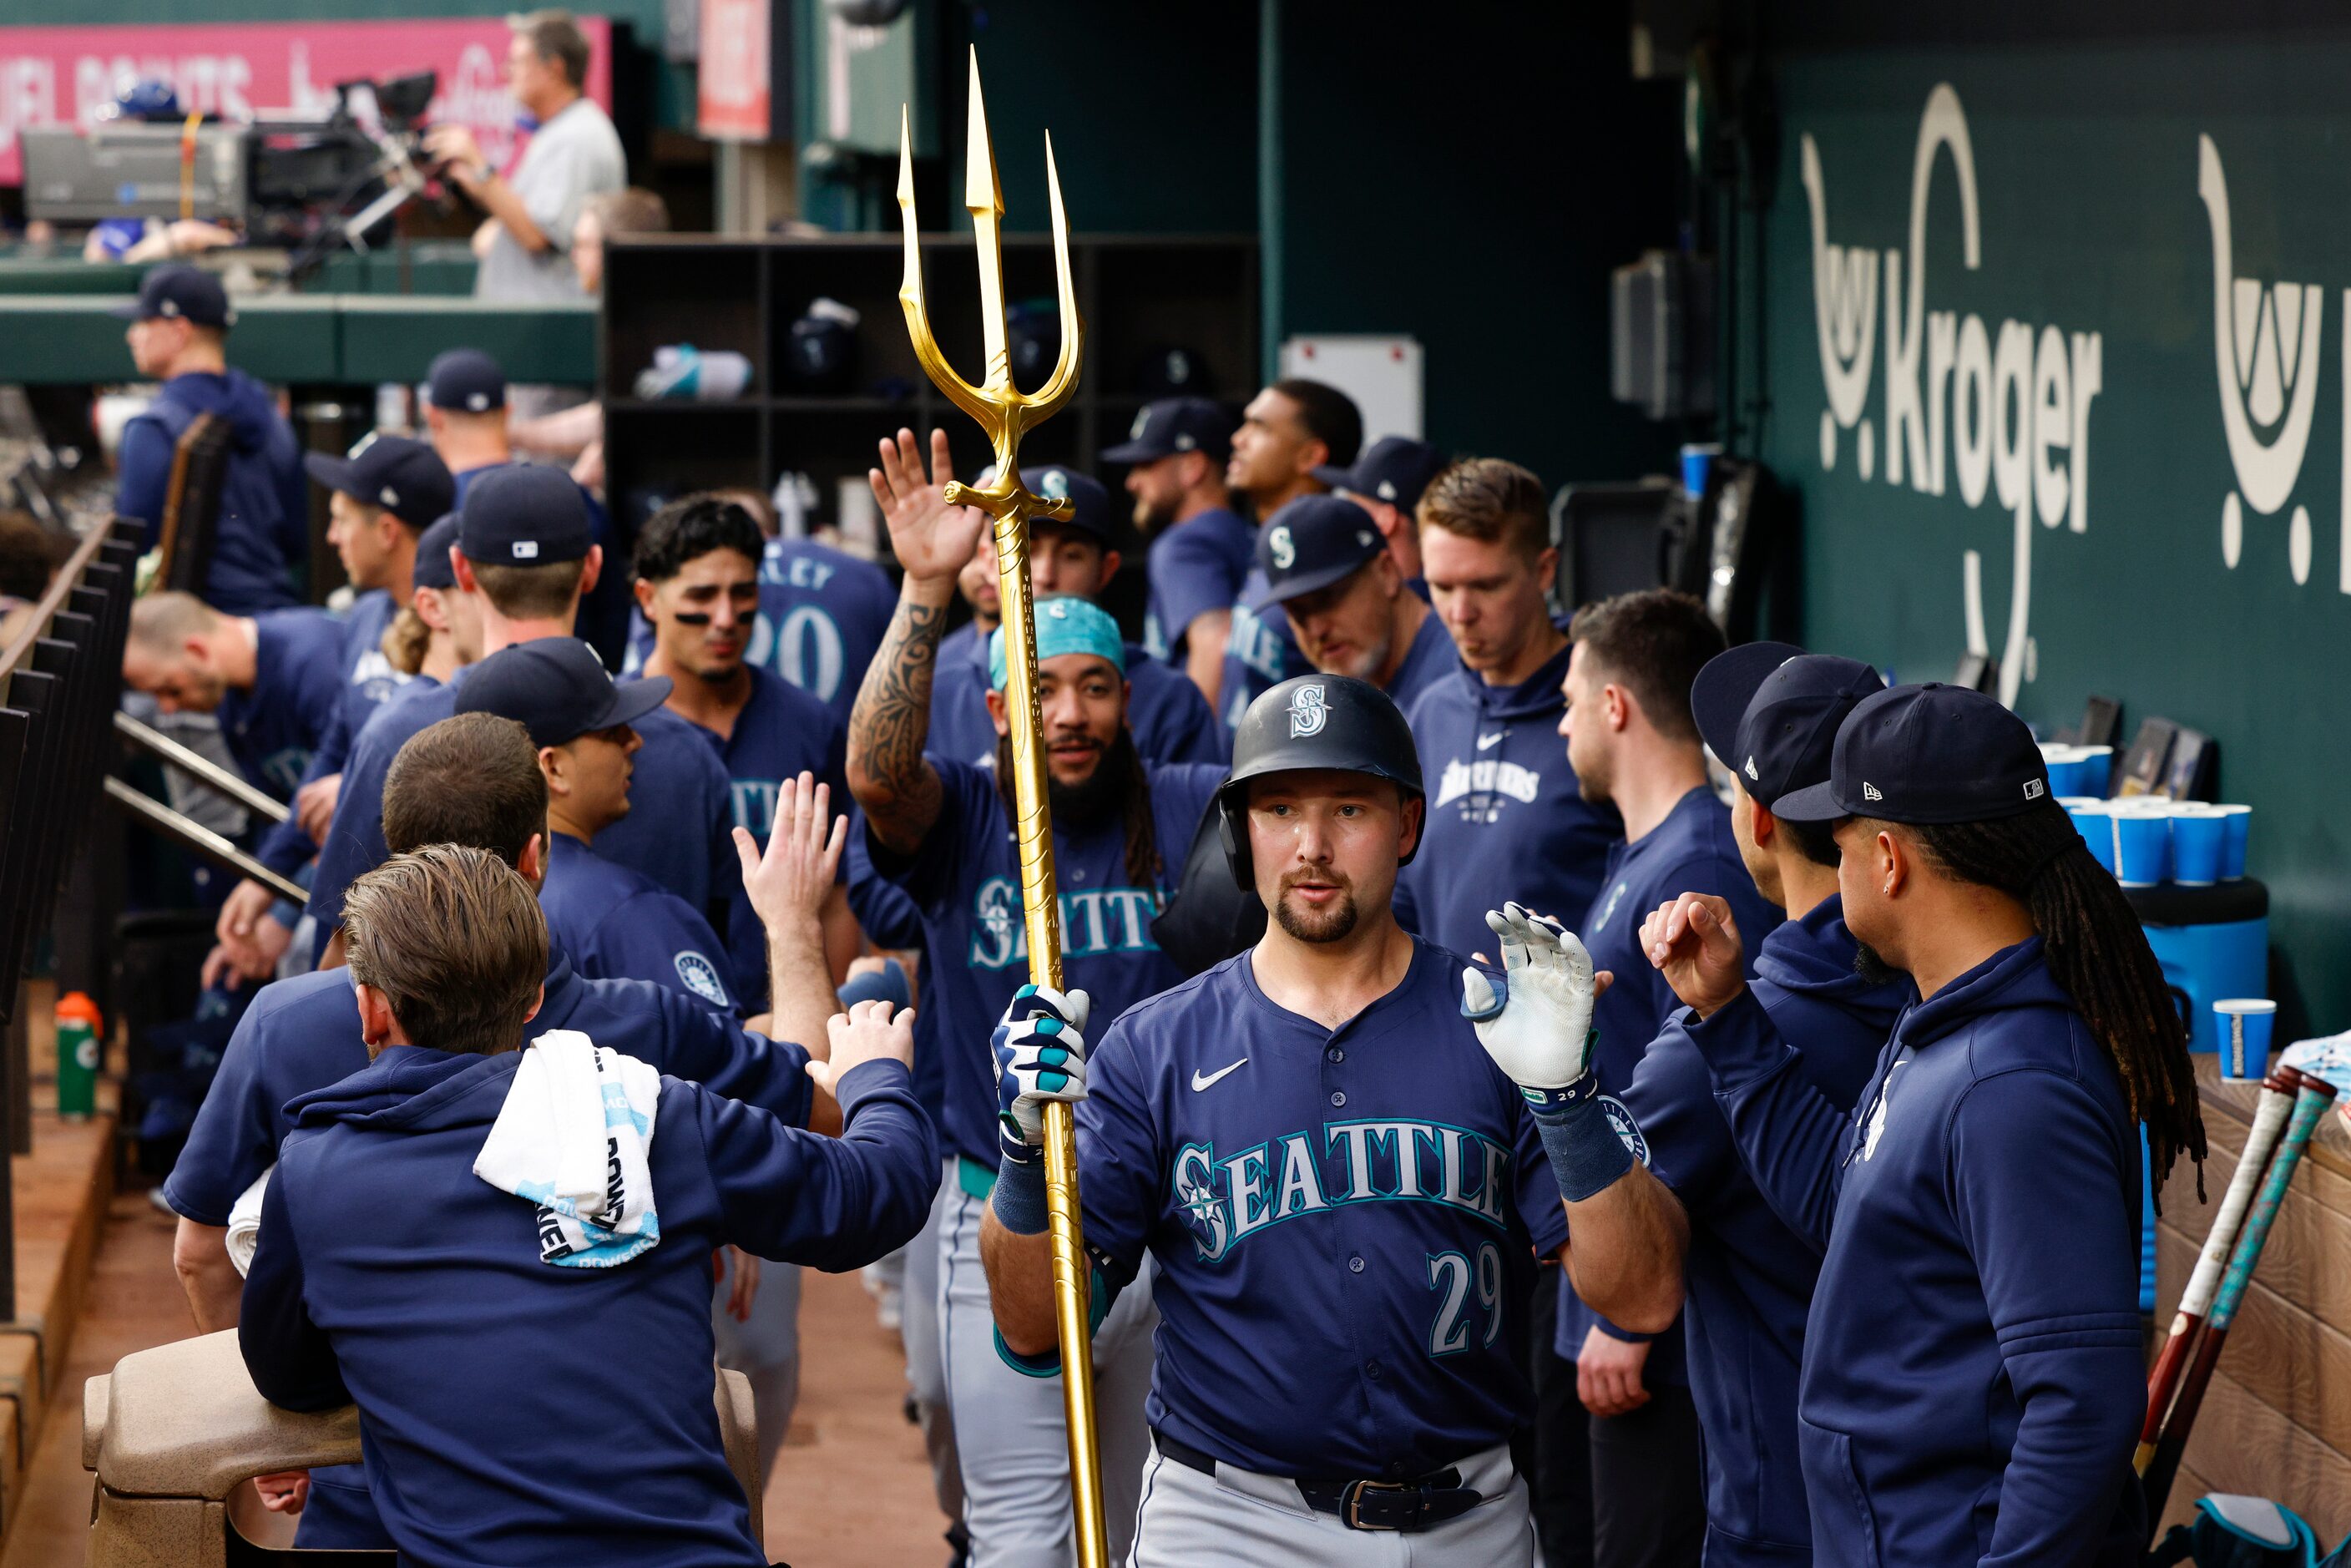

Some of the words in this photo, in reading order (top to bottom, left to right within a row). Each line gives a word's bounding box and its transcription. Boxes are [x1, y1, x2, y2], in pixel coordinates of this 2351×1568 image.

[1268, 525, 1297, 570] S
[1289, 684, 1327, 741] S
[1557, 1089, 1576, 1102] 29
[1171, 1117, 1515, 1263] SEATTLE
[1425, 1239, 1503, 1358] 29
